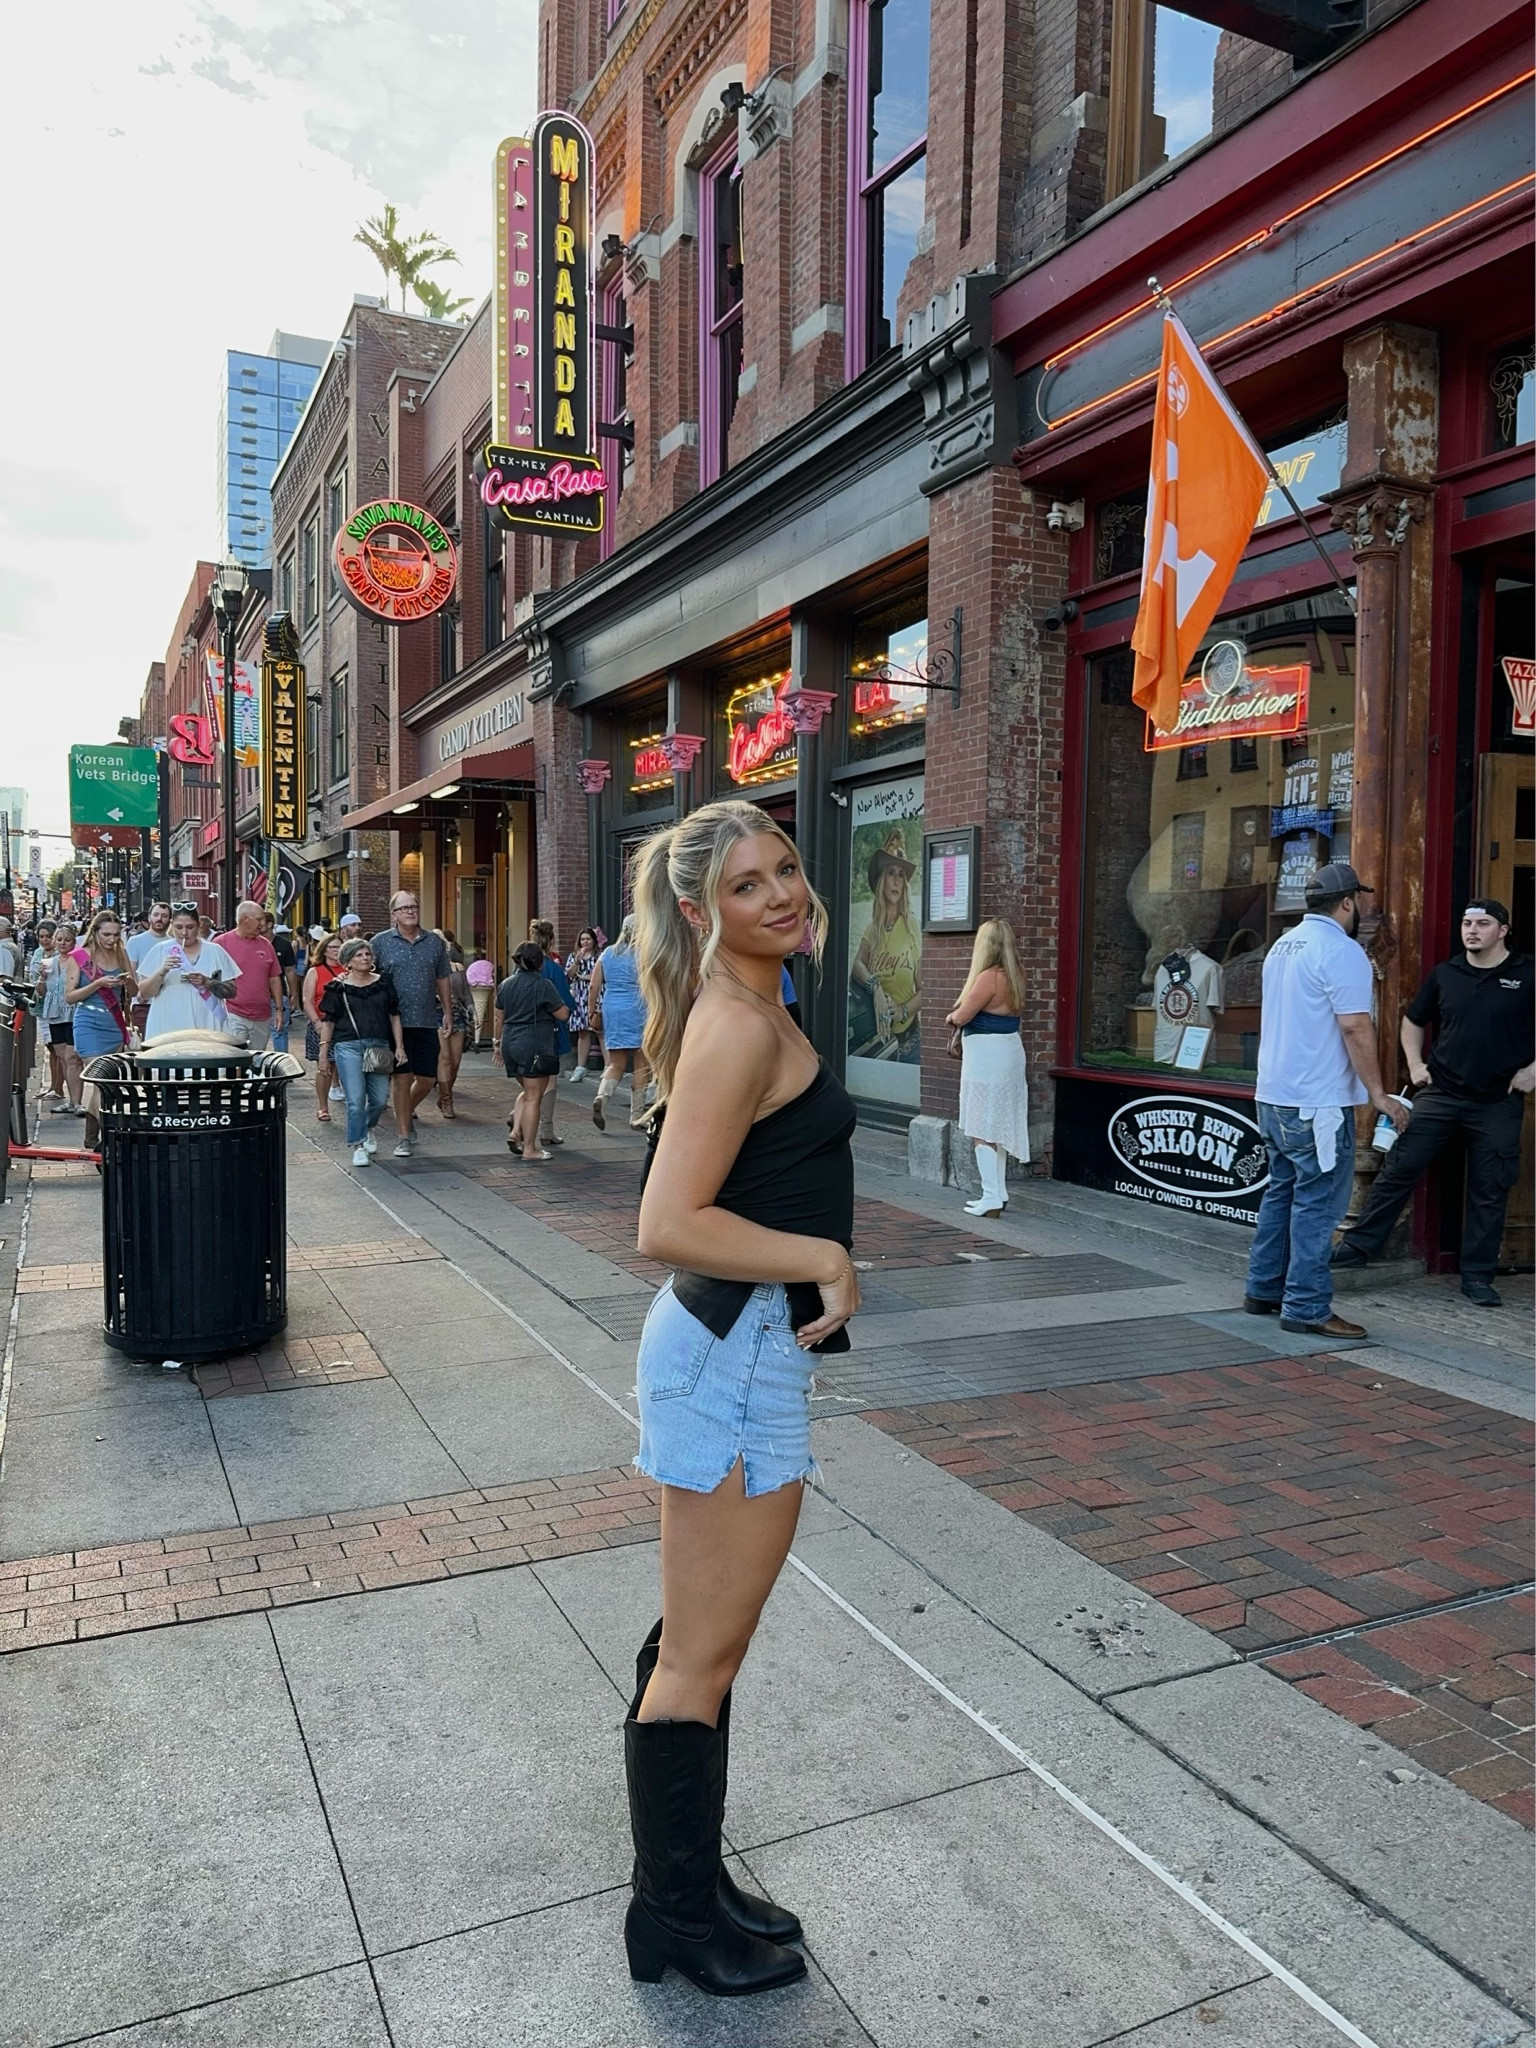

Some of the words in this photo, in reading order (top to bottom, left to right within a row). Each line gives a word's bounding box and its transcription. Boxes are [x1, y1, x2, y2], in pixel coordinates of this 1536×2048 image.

[513, 157, 531, 436] LAMBERT'S
[551, 135, 579, 437] MIRANDA
[491, 454, 547, 471] TEX-MEX
[481, 468, 552, 505] Casa
[547, 461, 608, 502] Rosa
[347, 502, 448, 552] SAVANNAH'S
[535, 510, 593, 527] CANTINA
[343, 557, 390, 611] CANDY
[394, 568, 451, 616] KITCHEN
[275, 662, 293, 671] the
[438, 726, 472, 762] CANDY
[473, 691, 524, 745] KITCHEN
[75, 753, 124, 767] Korean
[274, 674, 295, 838] VALENTINE
[76, 769, 106, 780] Vets
[112, 771, 157, 785] Bridge
[857, 800, 873, 816] New
[874, 790, 897, 810] Album
[1270, 940, 1307, 956] STAFF
[872, 951, 912, 976] illey's
[1184, 1046, 1201, 1058] $25
[164, 1115, 218, 1128] Recycle
[1134, 1109, 1197, 1129] WHISKEY
[1202, 1115, 1245, 1146] BENT
[1138, 1127, 1238, 1172] SALOON
[1138, 1159, 1182, 1175] NASHVILLE
[1184, 1168, 1235, 1185] TENNESSEE
[1115, 1180, 1155, 1199] LOCALLY
[1156, 1190, 1194, 1208] OWNED
[1195, 1199, 1203, 1211] &
